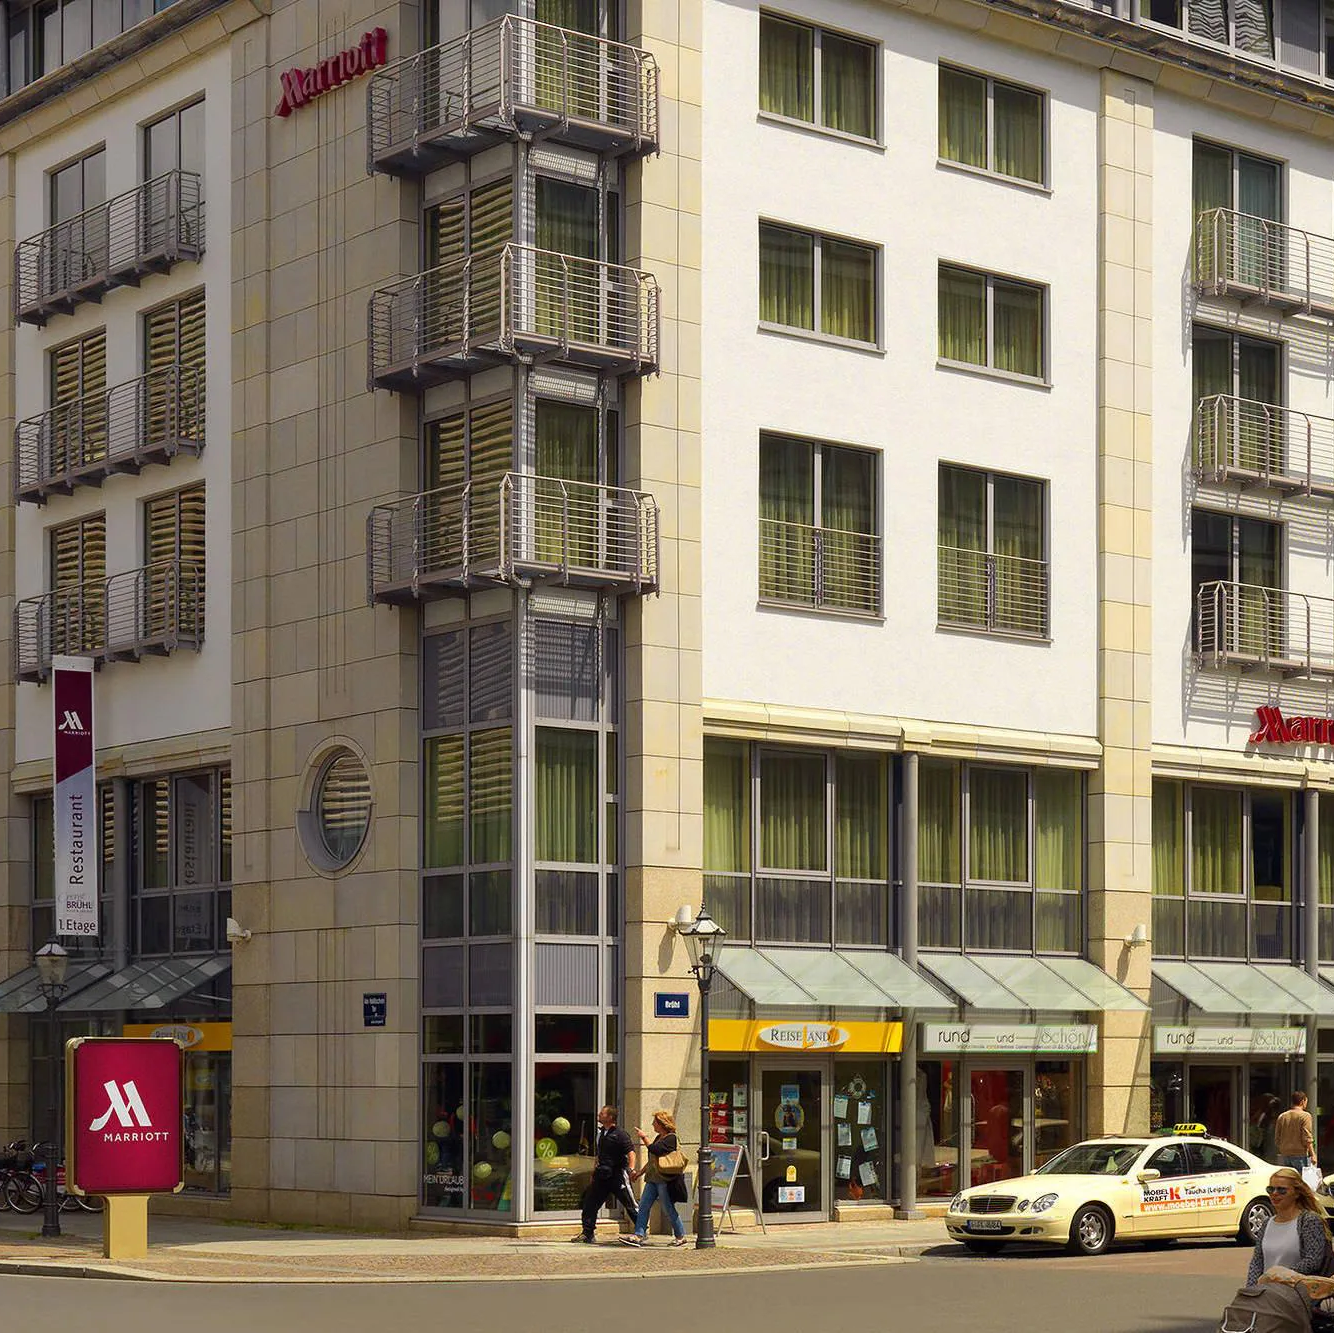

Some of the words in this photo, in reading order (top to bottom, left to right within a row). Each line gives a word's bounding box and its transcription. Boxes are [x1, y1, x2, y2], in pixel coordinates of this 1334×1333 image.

[274, 27, 388, 117] Marriott
[69, 794, 84, 885] Restaurant
[67, 919, 96, 933] Etage
[938, 1029, 970, 1043] rund
[996, 1033, 1014, 1043] und
[1167, 1032, 1195, 1044] rund
[1217, 1036, 1233, 1045] und
[104, 1132, 169, 1142] MARRIOTT
[1185, 1187, 1206, 1195] Taucha
[1208, 1185, 1232, 1194] (Leipzig)
